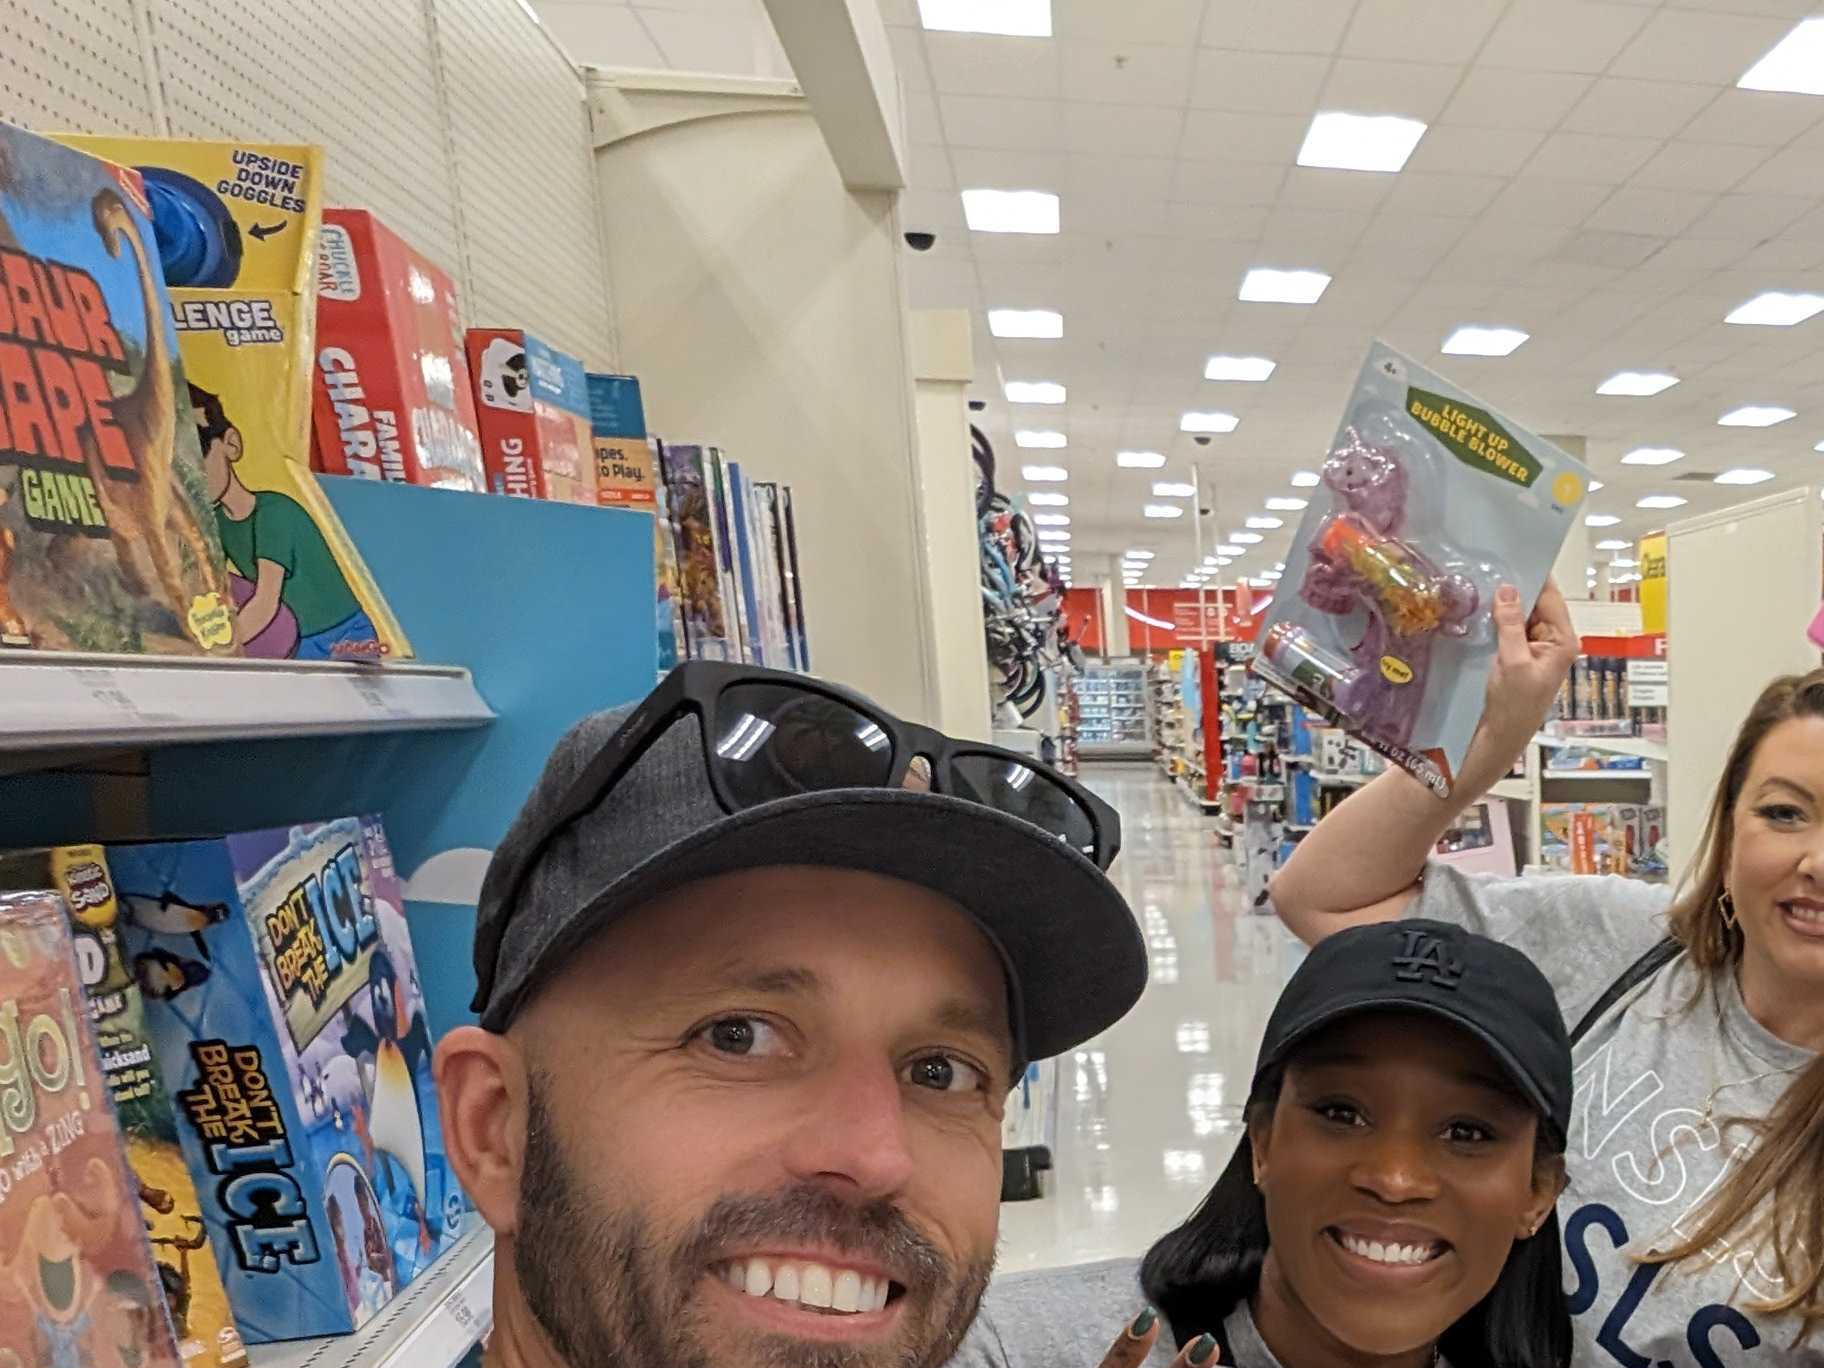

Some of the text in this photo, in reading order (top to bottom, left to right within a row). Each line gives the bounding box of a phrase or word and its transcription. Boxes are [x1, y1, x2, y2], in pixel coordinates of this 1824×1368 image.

[232, 150, 304, 180] UPSIDE
[237, 168, 296, 194] DOWN
[217, 180, 305, 214] GOGGLES
[225, 328, 283, 346] game
[1411, 401, 1528, 481] BUBBLE BLOWER
[1442, 405, 1509, 450] LIGHT UP
[22, 469, 107, 527] GAME
[267, 886, 310, 947] DON'T
[304, 846, 377, 971] ICE
[276, 918, 324, 990] BREAK
[302, 955, 330, 1004] THE
[1393, 930, 1463, 990] LA
[185, 1084, 227, 1139] THE
[200, 1045, 260, 1144] BREAK
[235, 1051, 284, 1135] DON'T
[46, 1110, 84, 1154] ZING
[211, 1139, 320, 1272] ICE
